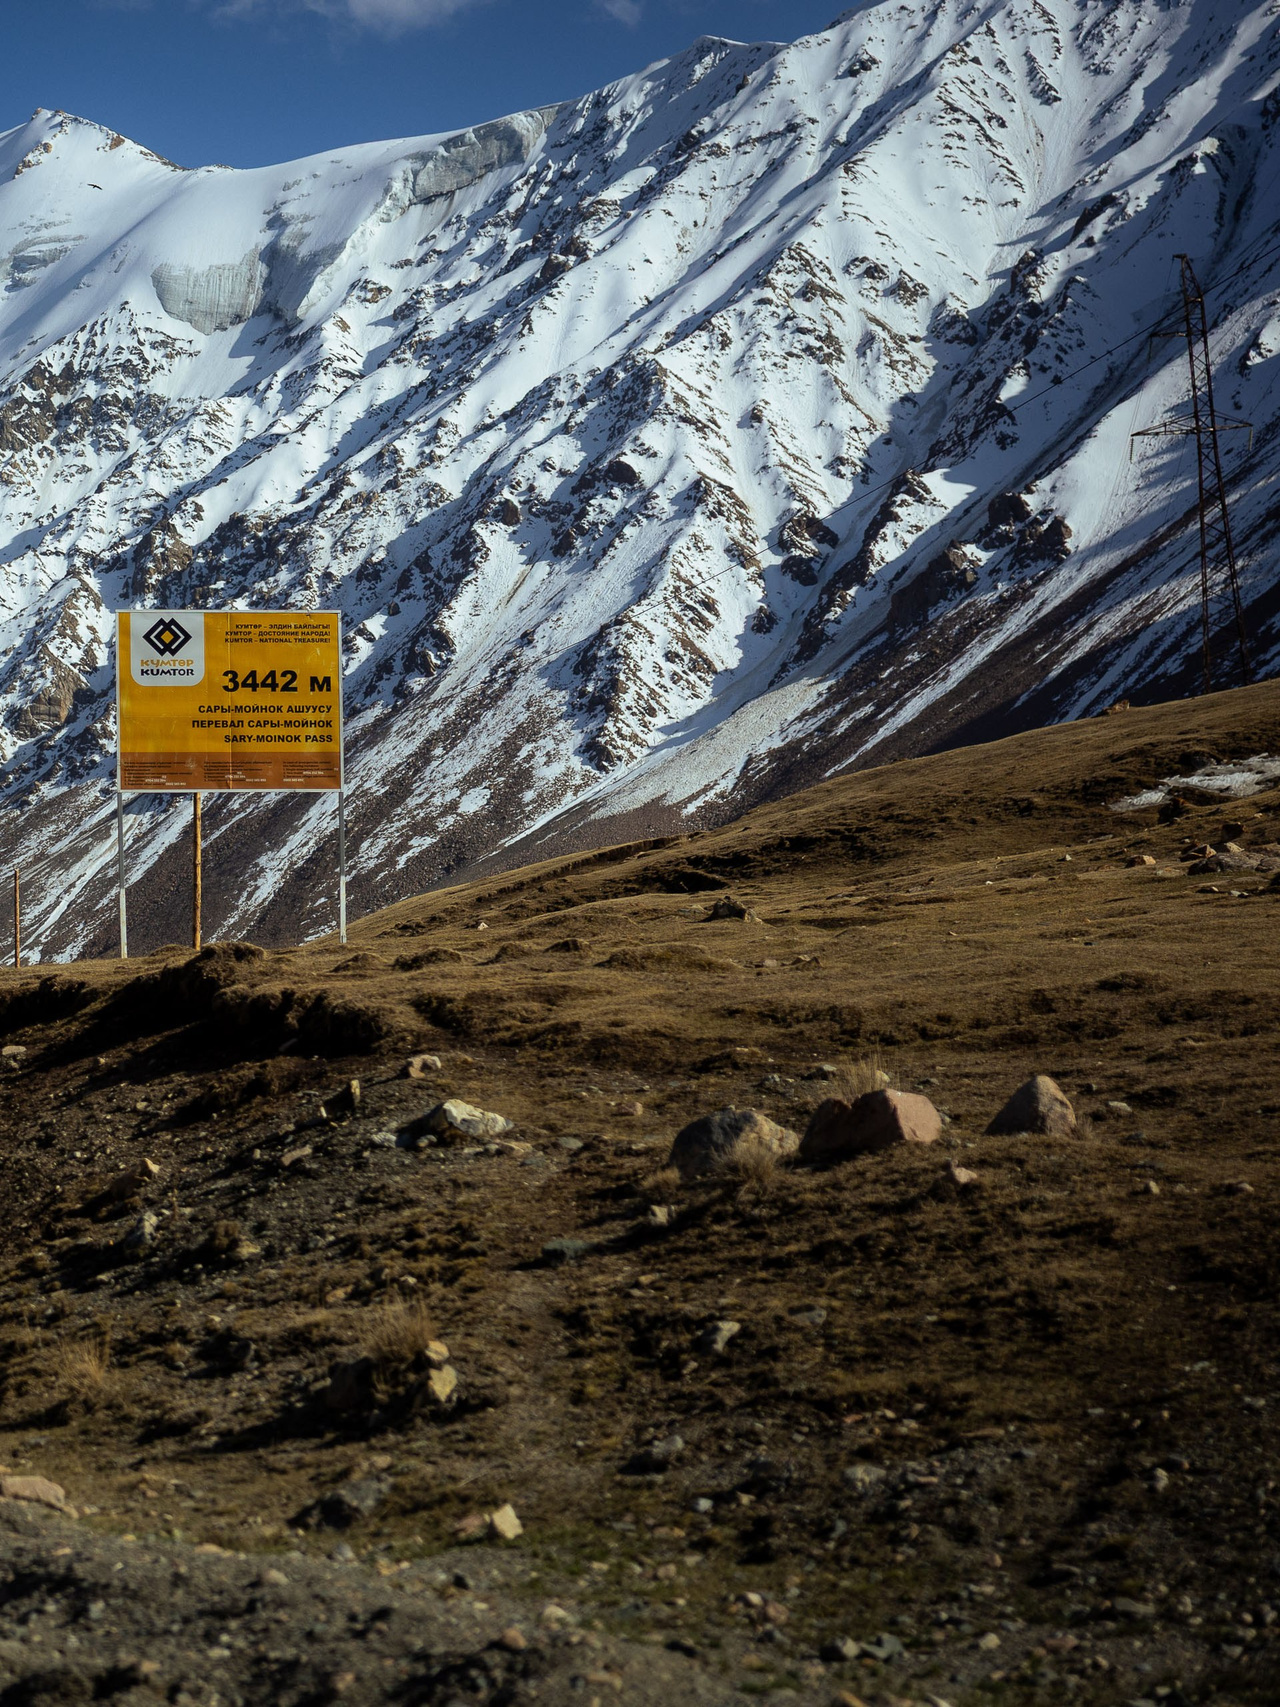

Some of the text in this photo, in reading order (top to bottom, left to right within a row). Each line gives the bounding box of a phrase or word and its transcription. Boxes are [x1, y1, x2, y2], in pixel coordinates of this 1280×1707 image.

[140, 668, 195, 676] KUMTOR
[222, 670, 298, 693] 3442
[198, 704, 332, 714] САРЫ-МОЙНОК АШУУСУ
[192, 718, 333, 728] ПЕРЕВАЛ САРЫ-МОЙНОК
[224, 735, 333, 743] SARY-MOINOK PASS
